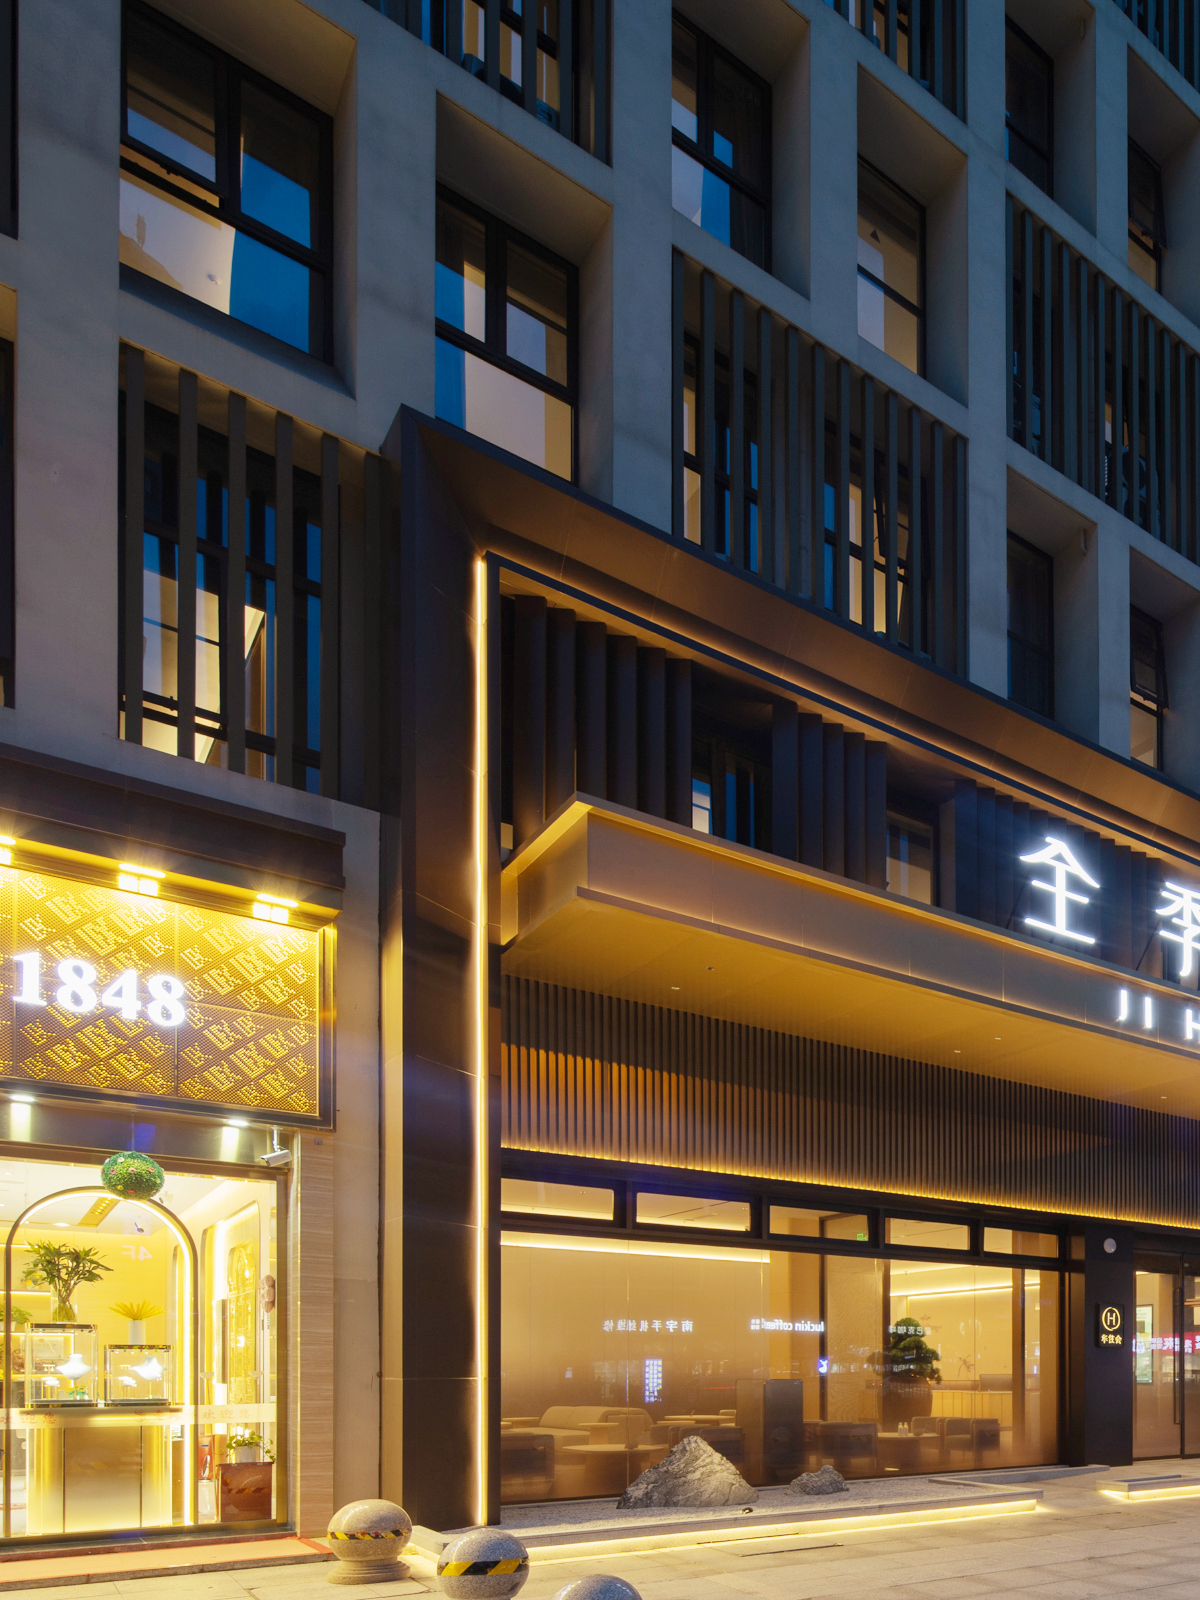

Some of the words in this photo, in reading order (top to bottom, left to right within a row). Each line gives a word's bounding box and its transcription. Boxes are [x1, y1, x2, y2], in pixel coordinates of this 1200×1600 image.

[12, 951, 186, 1027] 1848
[1118, 989, 1152, 1028] JI
[1101, 1333, 1122, 1345] 华住会
